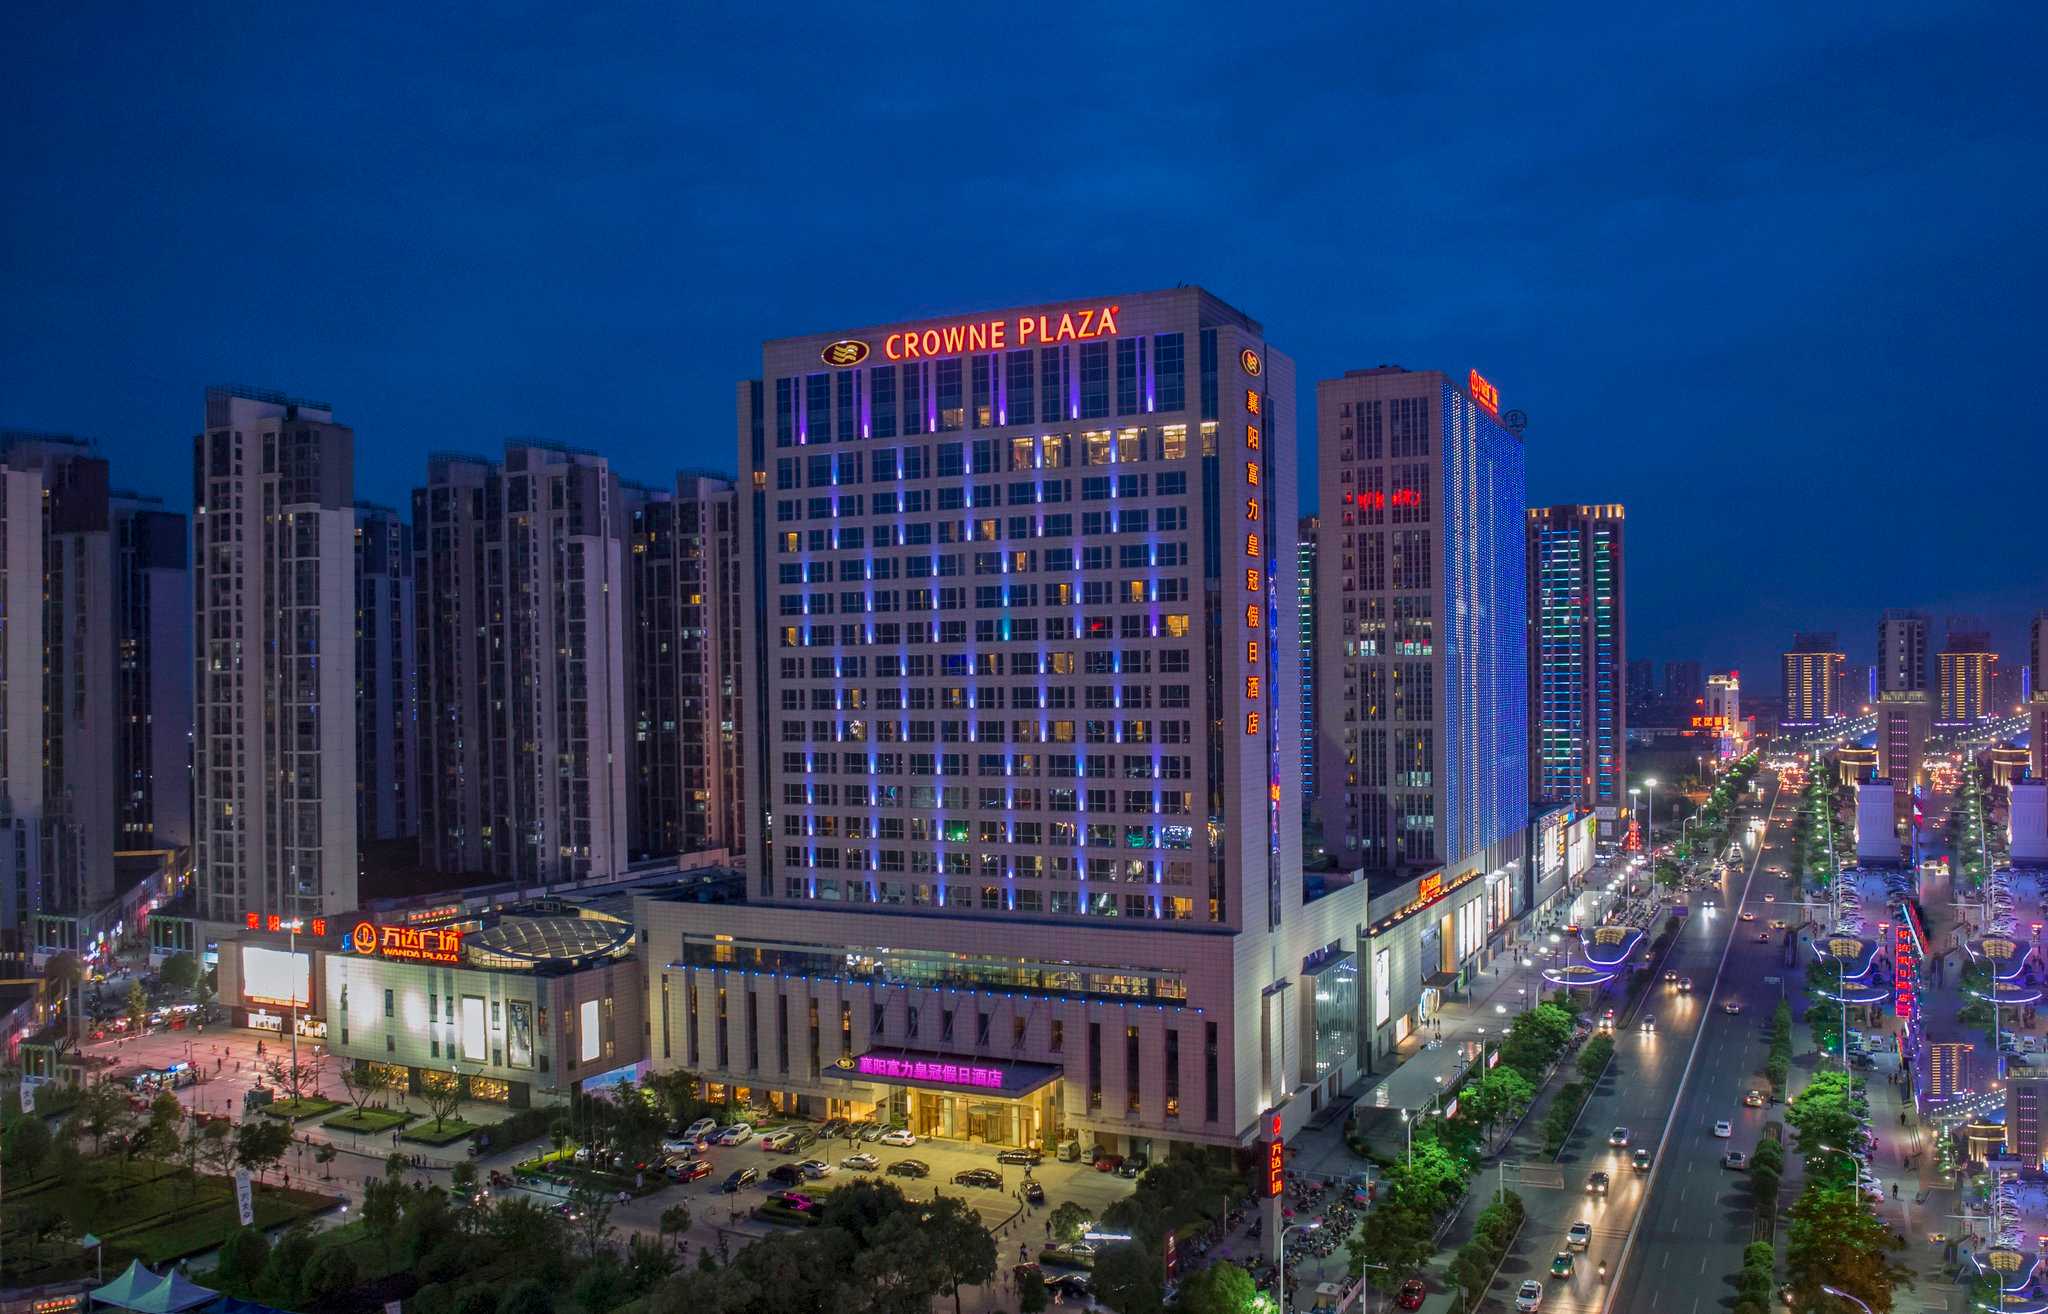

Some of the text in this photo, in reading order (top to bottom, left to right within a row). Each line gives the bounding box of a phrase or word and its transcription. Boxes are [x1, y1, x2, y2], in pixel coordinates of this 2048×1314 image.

[885, 307, 1118, 360] CROWNE PLAZA
[1246, 390, 1260, 736] 襄阳富力皇冠假日酒店
[382, 926, 459, 952] 万达广场
[383, 948, 458, 962] WANDA PLAZA
[860, 1057, 1002, 1088] 襄阳富力皇冠假日酒店
[1271, 1143, 1282, 1194] 万达广场
